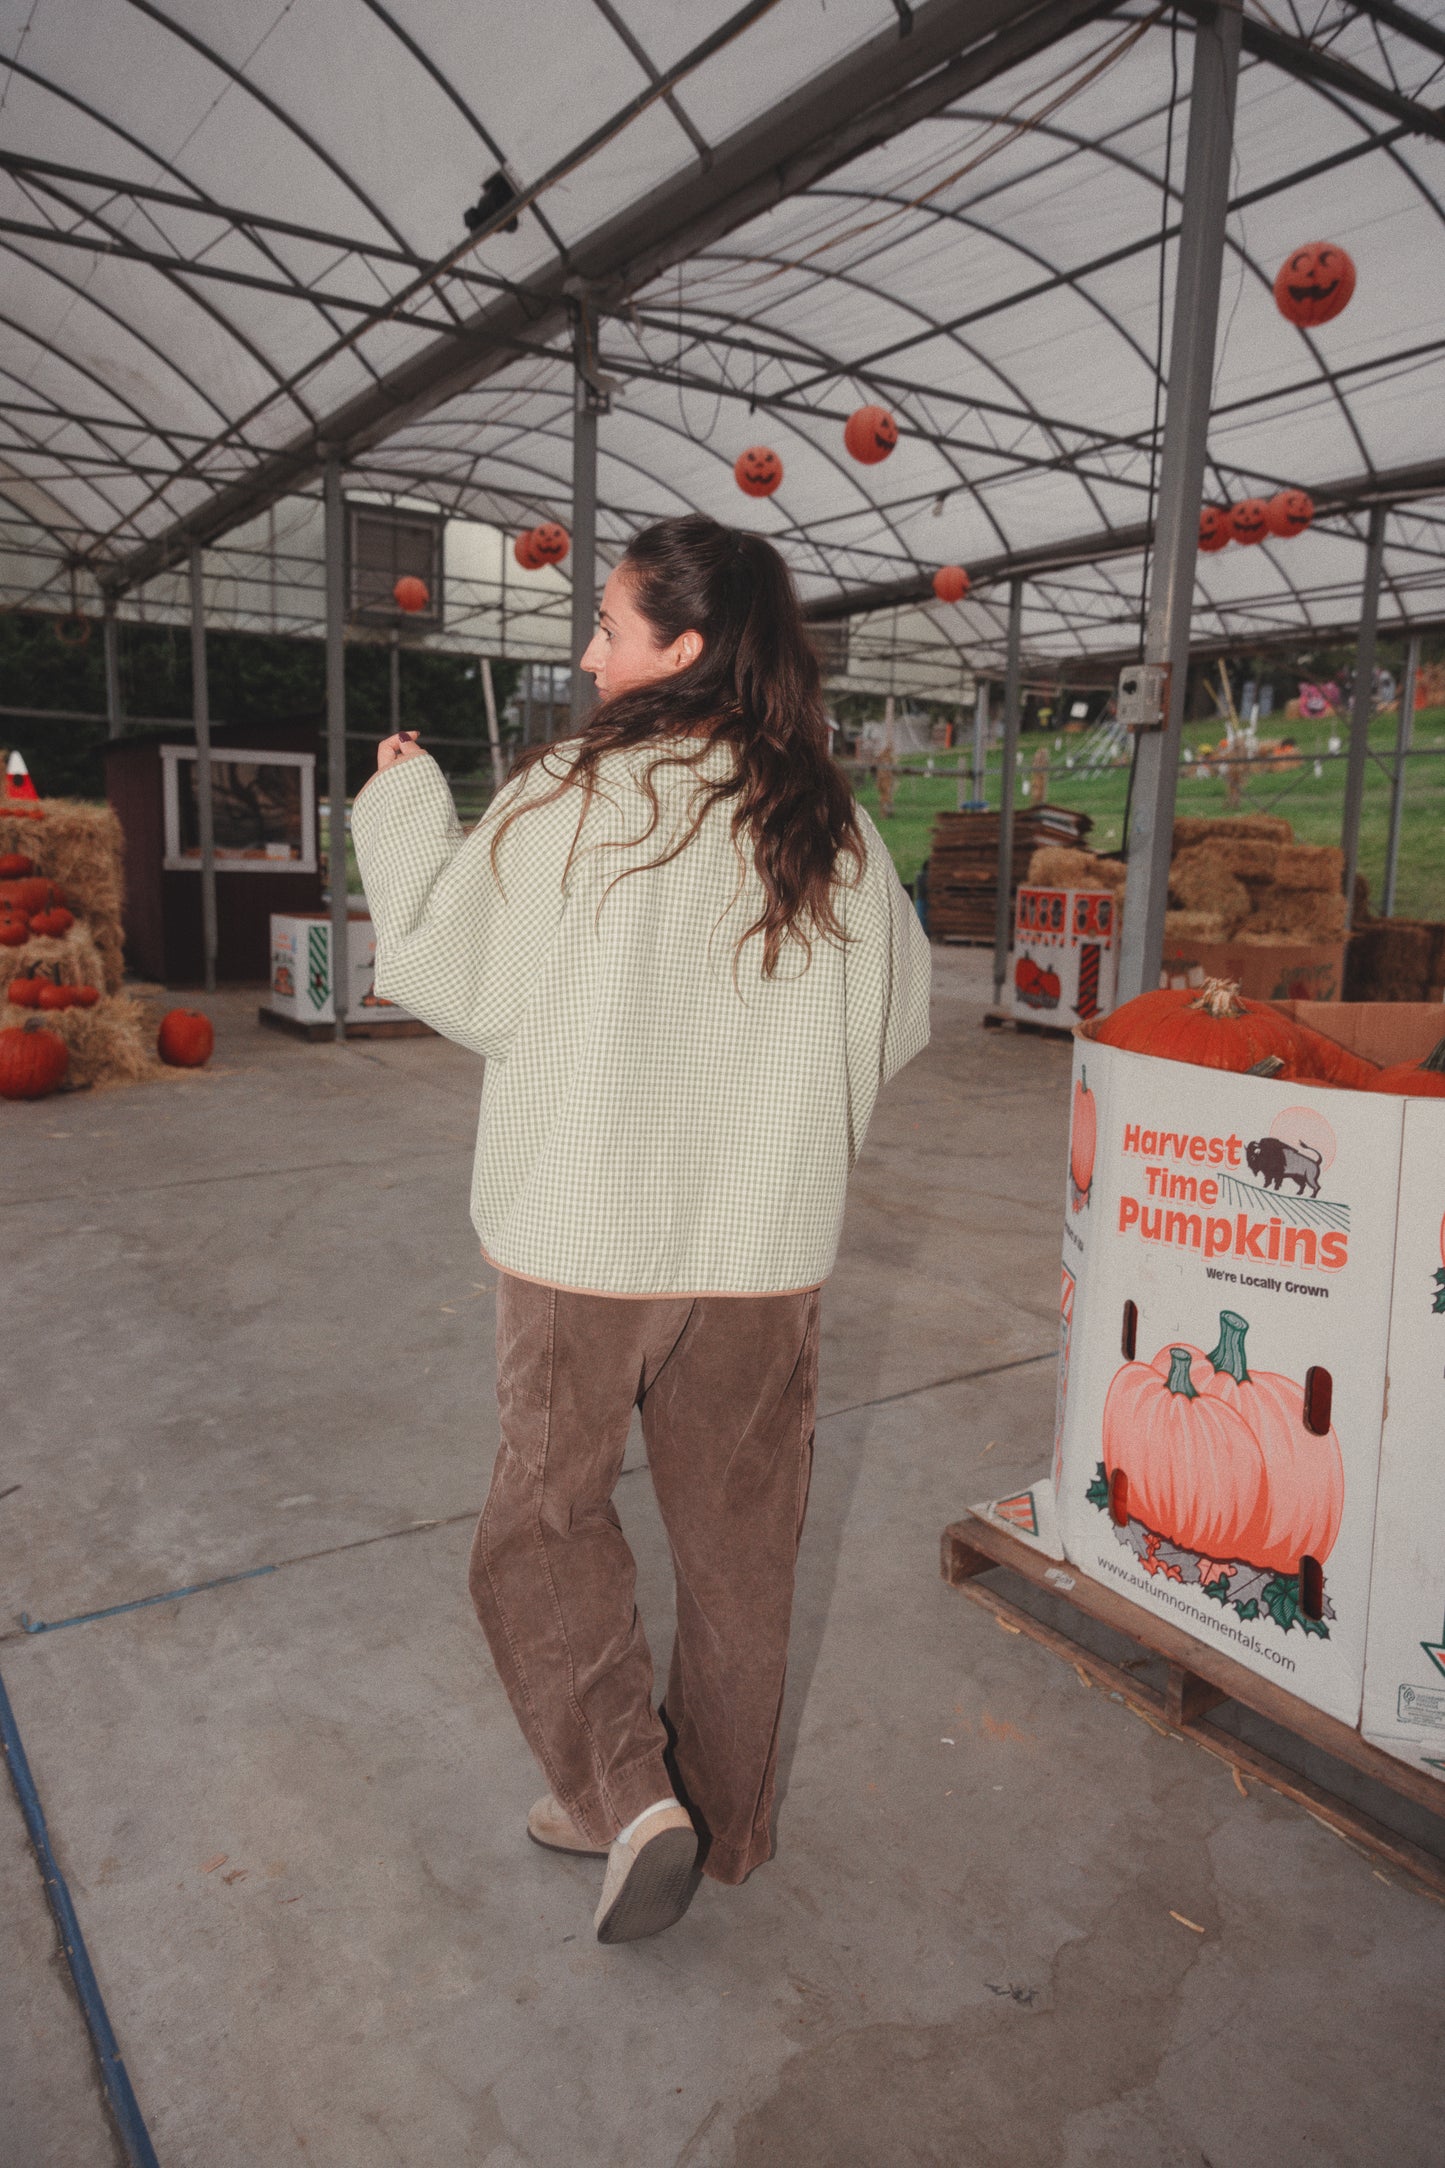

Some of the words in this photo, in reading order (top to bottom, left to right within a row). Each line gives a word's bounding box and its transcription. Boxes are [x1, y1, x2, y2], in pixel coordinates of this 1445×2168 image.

[1122, 1123, 1243, 1168] Harvest
[1145, 1166, 1219, 1206] Time
[1118, 1195, 1348, 1270] Pumpkins
[1206, 1267, 1238, 1284] We're
[1240, 1274, 1282, 1293] Locally
[1285, 1282, 1329, 1298] Grown
[1097, 1556, 1296, 1673] www.autumnornamentals.com
